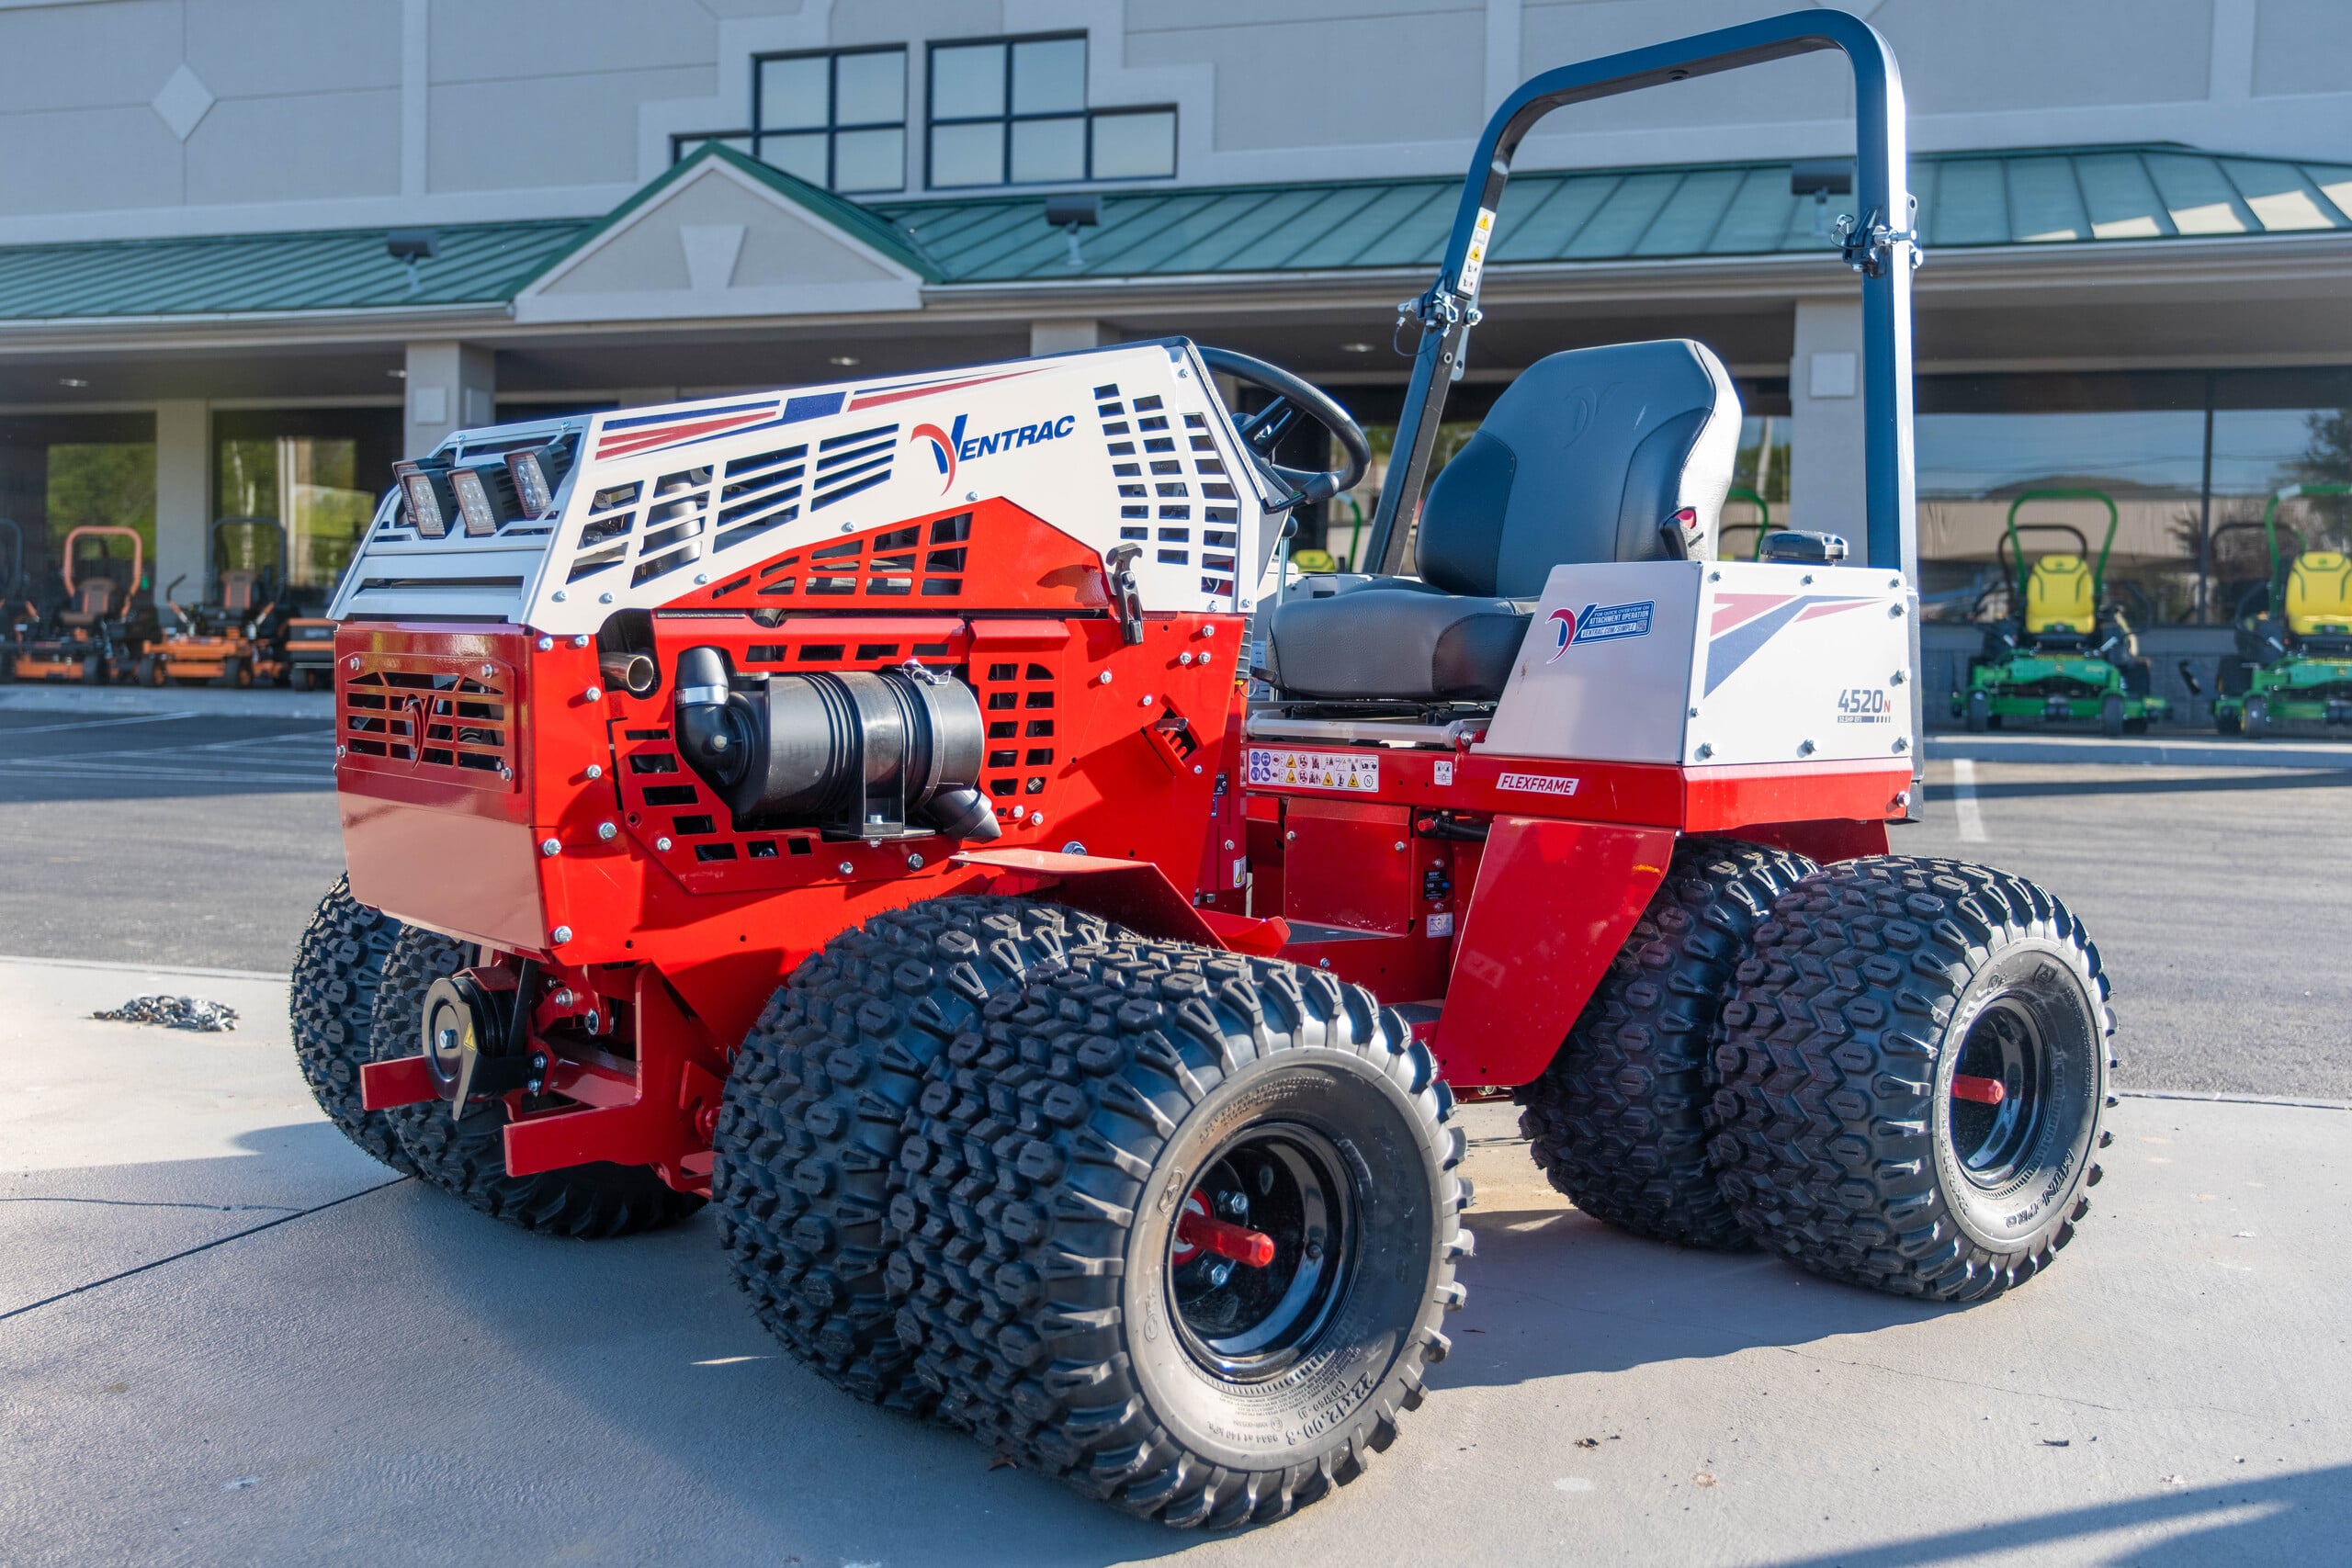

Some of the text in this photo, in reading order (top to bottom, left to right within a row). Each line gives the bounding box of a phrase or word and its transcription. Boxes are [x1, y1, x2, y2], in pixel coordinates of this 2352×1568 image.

[910, 413, 1075, 496] VENTRAC
[1589, 610, 1649, 625] ATTACHMENT OPERATION
[1582, 623, 1635, 637] VENTRAC.COM/SIMPLE
[1501, 775, 1574, 794] FLEXFRAME
